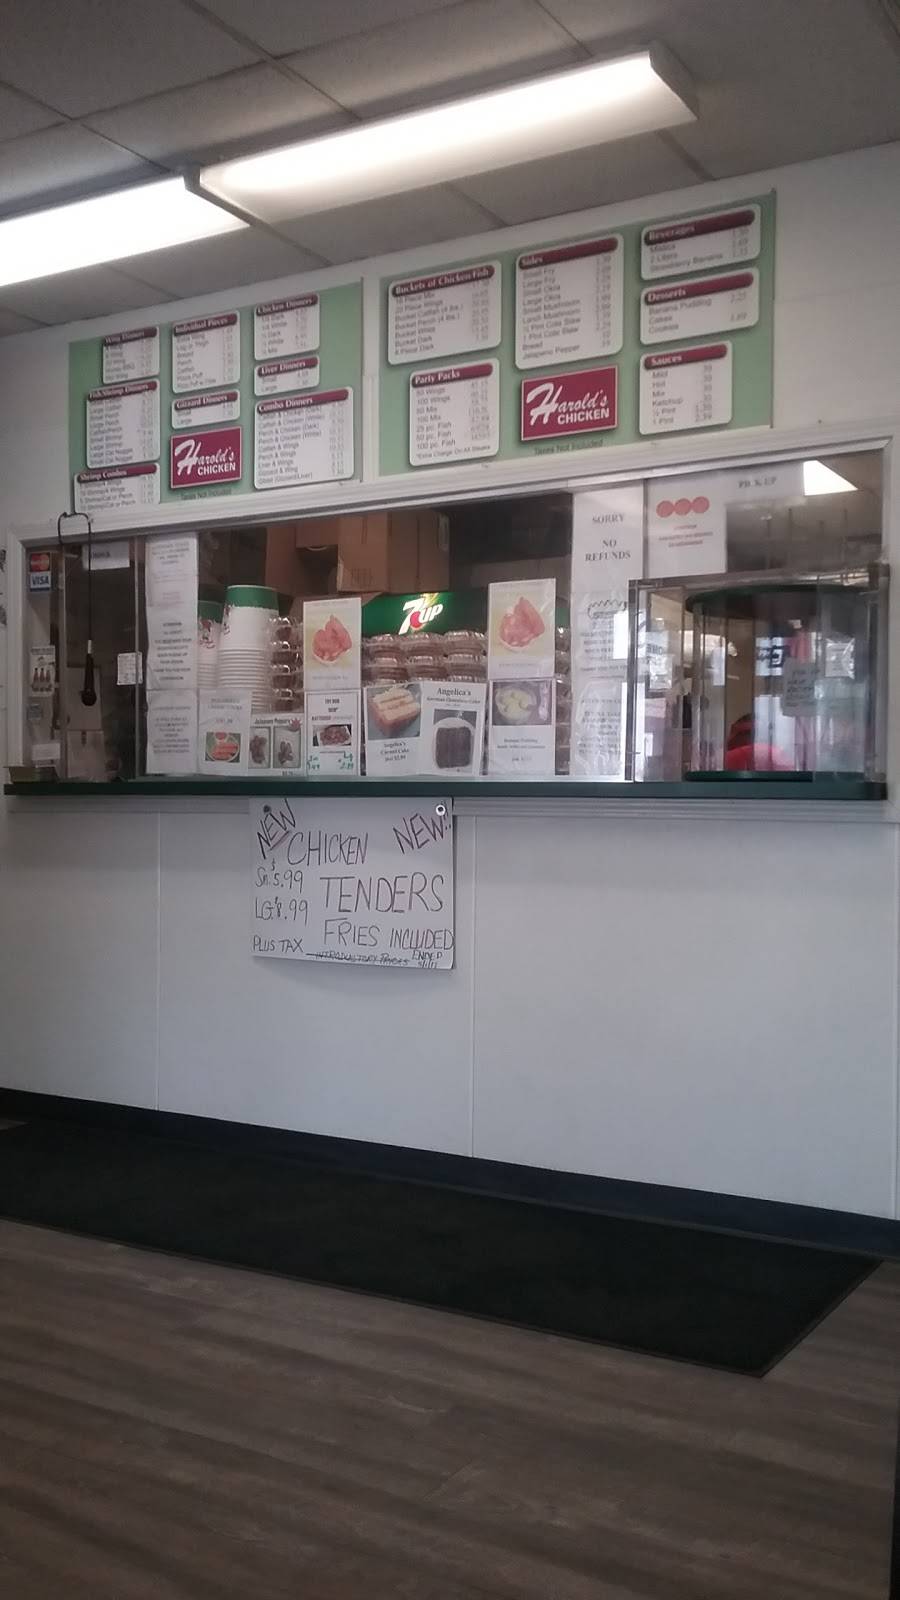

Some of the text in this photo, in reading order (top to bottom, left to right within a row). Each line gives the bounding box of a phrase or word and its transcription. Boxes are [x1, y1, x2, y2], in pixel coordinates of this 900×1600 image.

[649, 225, 695, 240] Beverages
[521, 256, 543, 266] Sides
[395, 283, 426, 295] Buckets
[427, 279, 437, 288] of
[648, 289, 687, 303] Desserts
[651, 355, 682, 366] Sauces
[415, 368, 461, 386] Party Packs
[259, 397, 313, 413] Combo Dinners
[526, 382, 608, 426] Harold's
[557, 408, 610, 425] CHICKEN
[174, 439, 235, 476] Harold's
[197, 461, 237, 476] CHICKEN
[763, 476, 777, 486] UP
[592, 513, 625, 524] SORRY
[602, 539, 617, 548] NO
[585, 551, 631, 562] REFUNDS
[32, 575, 49, 585] VISA
[437, 687, 472, 697] Angelica's
[256, 798, 296, 860] NEW
[287, 830, 369, 867] CHICKEN
[319, 871, 444, 914] TENDERS
[324, 917, 455, 951] FRIES INCLUDED
[253, 934, 304, 953] PLUS TAX
